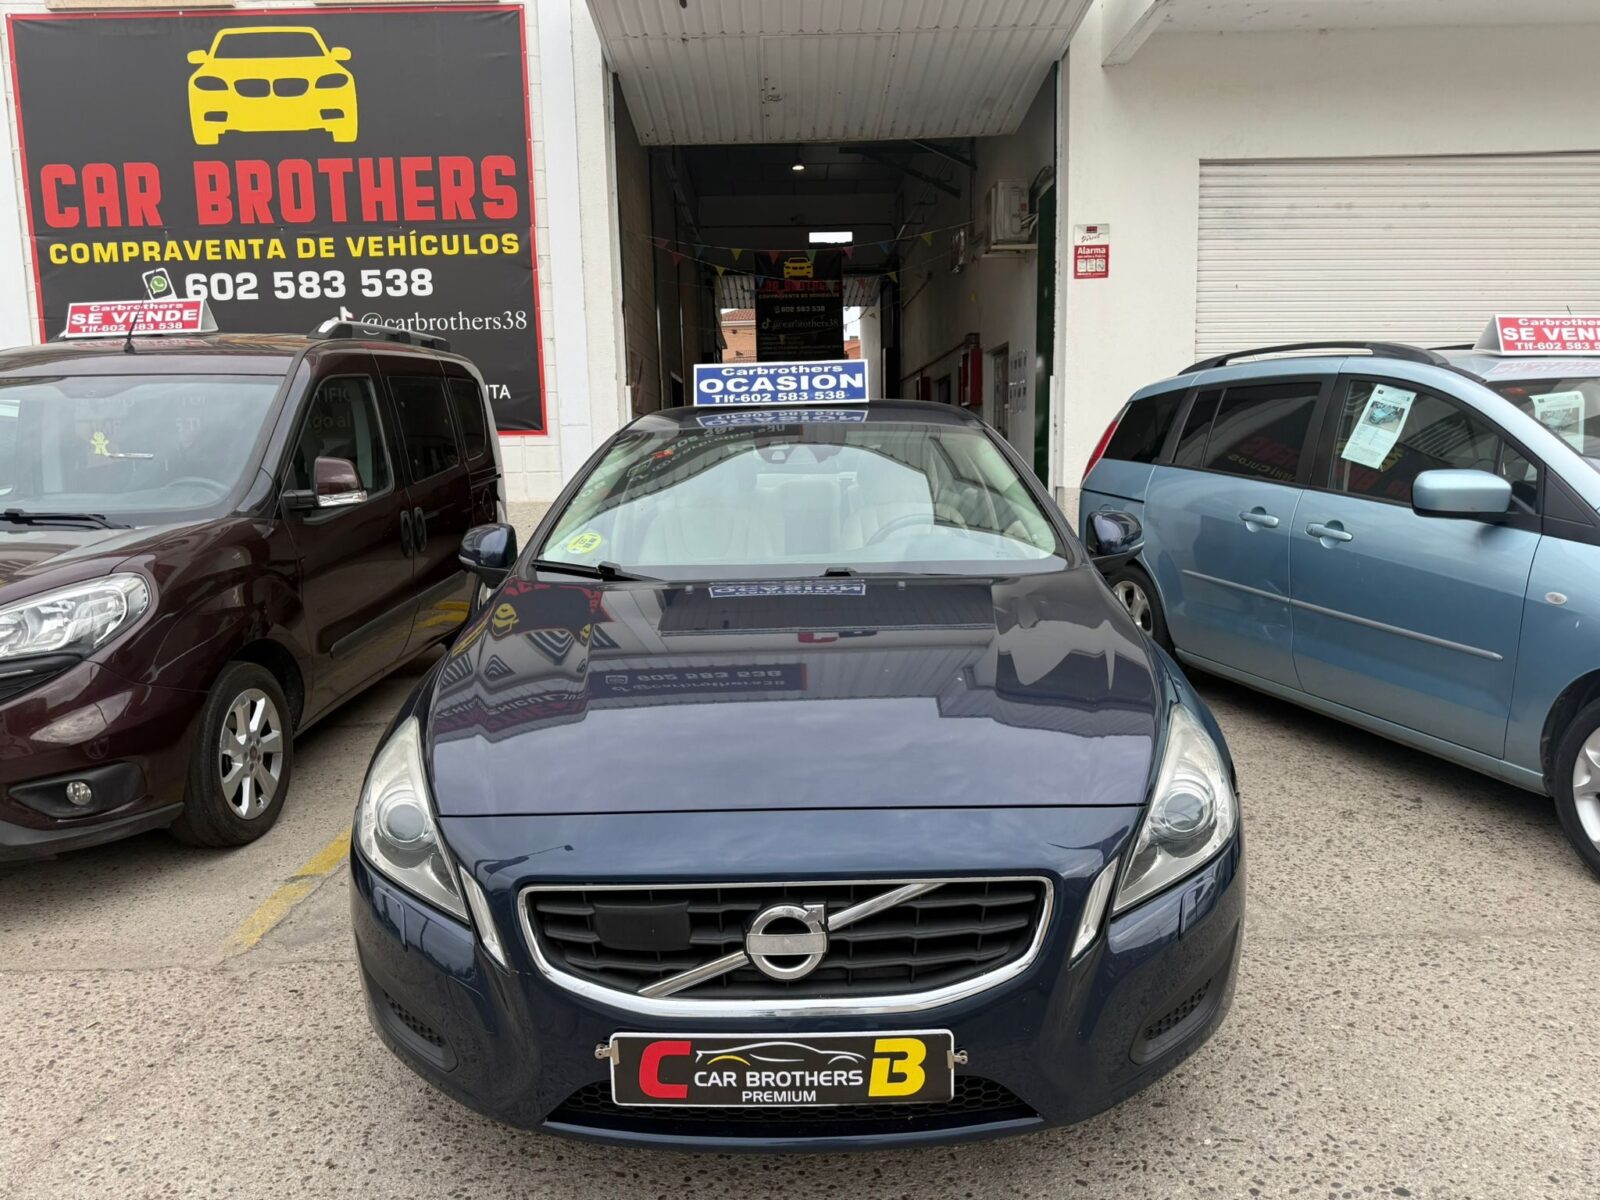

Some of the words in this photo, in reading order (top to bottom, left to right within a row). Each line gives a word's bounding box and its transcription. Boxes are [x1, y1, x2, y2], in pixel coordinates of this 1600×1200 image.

[40, 163, 163, 228] CAR
[193, 155, 518, 225] BROTHERS
[49, 237, 285, 265] COMPRAVENTA
[297, 236, 334, 259] DE
[346, 230, 520, 258] VEHÍCULOS
[185, 272, 259, 300] 602
[273, 270, 346, 299] 583
[361, 268, 433, 298] 538
[90, 303, 184, 312] Carbrothers
[71, 313, 103, 325] SE
[112, 309, 199, 323] VENDE
[361, 310, 527, 335] @carbrothers38
[159, 322, 183, 330] 538
[1502, 327, 1536, 341] SE
[1542, 327, 1600, 341] VEN
[1566, 341, 1591, 350] 583
[721, 365, 843, 376] Carbrothers
[699, 373, 864, 394] OCASION
[778, 392, 809, 402] 583
[814, 390, 846, 400] 538
[638, 1040, 692, 1098] C
[694, 1071, 737, 1088] CAR
[746, 1070, 863, 1087] BROTHERS
[742, 1090, 816, 1103] PREMIUM
